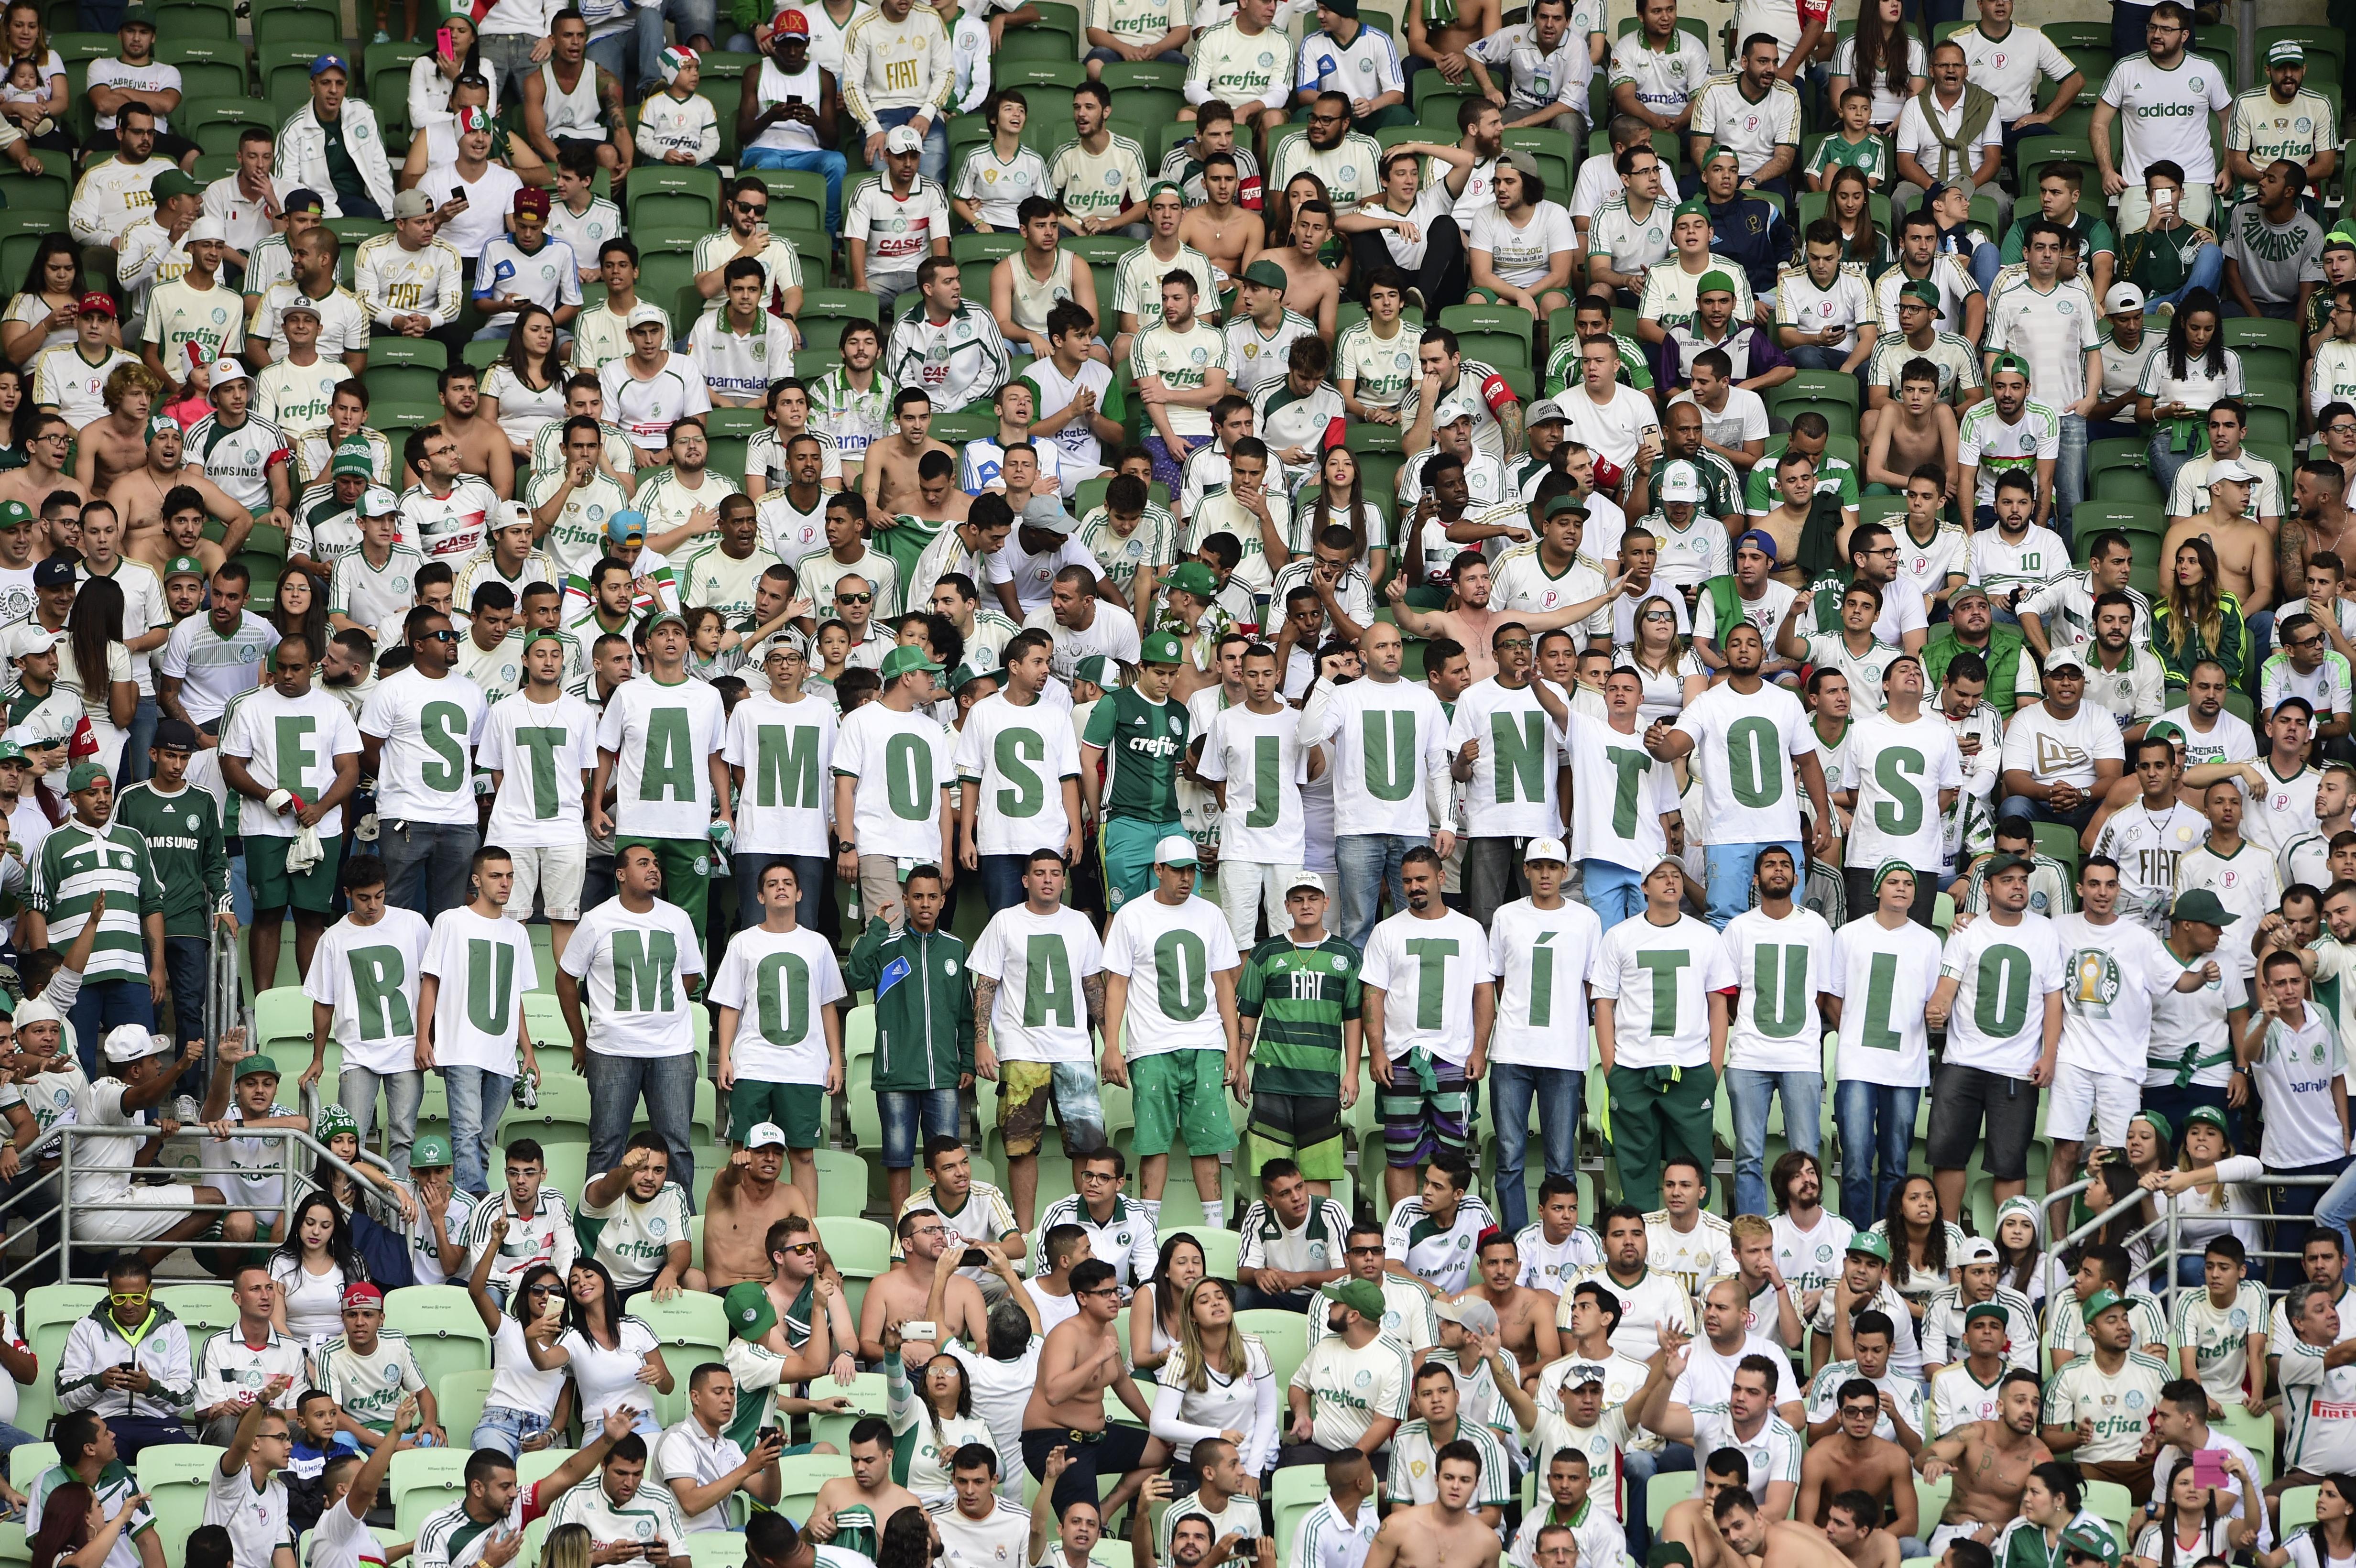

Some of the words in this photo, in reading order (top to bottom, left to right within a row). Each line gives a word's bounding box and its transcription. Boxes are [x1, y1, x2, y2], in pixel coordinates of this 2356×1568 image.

[1807, 0, 1825, 11] FAST
[1115, 12, 1167, 33] crefisa
[886, 59, 917, 90] FIAT
[1219, 74, 1269, 91] crefisa
[2138, 102, 2194, 118] adidas
[660, 137, 701, 149] crefisa
[2256, 140, 2311, 158] crefisa
[124, 191, 154, 209] FIA
[1070, 190, 1119, 210] crefisa
[1243, 189, 1261, 200] FAST
[880, 237, 923, 249] CASE
[2241, 212, 2308, 262] PALMEIRAS
[1526, 246, 1543, 255] 2012
[387, 283, 424, 307] FIAT
[172, 328, 221, 345] crefisa
[923, 366, 950, 376] CAS
[1159, 368, 1205, 385] refisa
[707, 376, 769, 391] parmalat
[284, 400, 327, 421] crefis
[207, 467, 257, 477] SAMSUNG
[436, 532, 480, 550] CASE
[552, 524, 598, 544] refisa
[2021, 553, 2040, 571] 10
[1832, 592, 1842, 610] 5
[82, 732, 95, 744] FAS
[421, 701, 468, 792] S
[276, 716, 318, 804] E
[640, 708, 696, 802] A
[1362, 710, 1416, 801] U
[1491, 711, 1545, 804] N
[515, 727, 567, 819] T
[757, 724, 819, 808] M
[994, 728, 1044, 817] S
[1606, 745, 1652, 840] T
[1875, 746, 1925, 836] S
[145, 837, 198, 850] AMSUNG
[2139, 849, 2181, 885] FIAT
[612, 929, 677, 1012] M
[1022, 934, 1076, 1028] A
[1529, 931, 1559, 1027] Í
[347, 945, 414, 1041] R
[467, 938, 514, 1035] U
[1291, 971, 1326, 1002] FIAT
[1406, 938, 1459, 1030] T
[1636, 949, 1691, 1037] T
[1753, 943, 1809, 1039] U
[1861, 952, 1901, 1051] L
[337, 1118, 355, 1128] SEP
[1417, 1261, 1466, 1277] SAMSUNG
[349, 1387, 400, 1411] crefisa
[1318, 1389, 1366, 1410] crefisa
